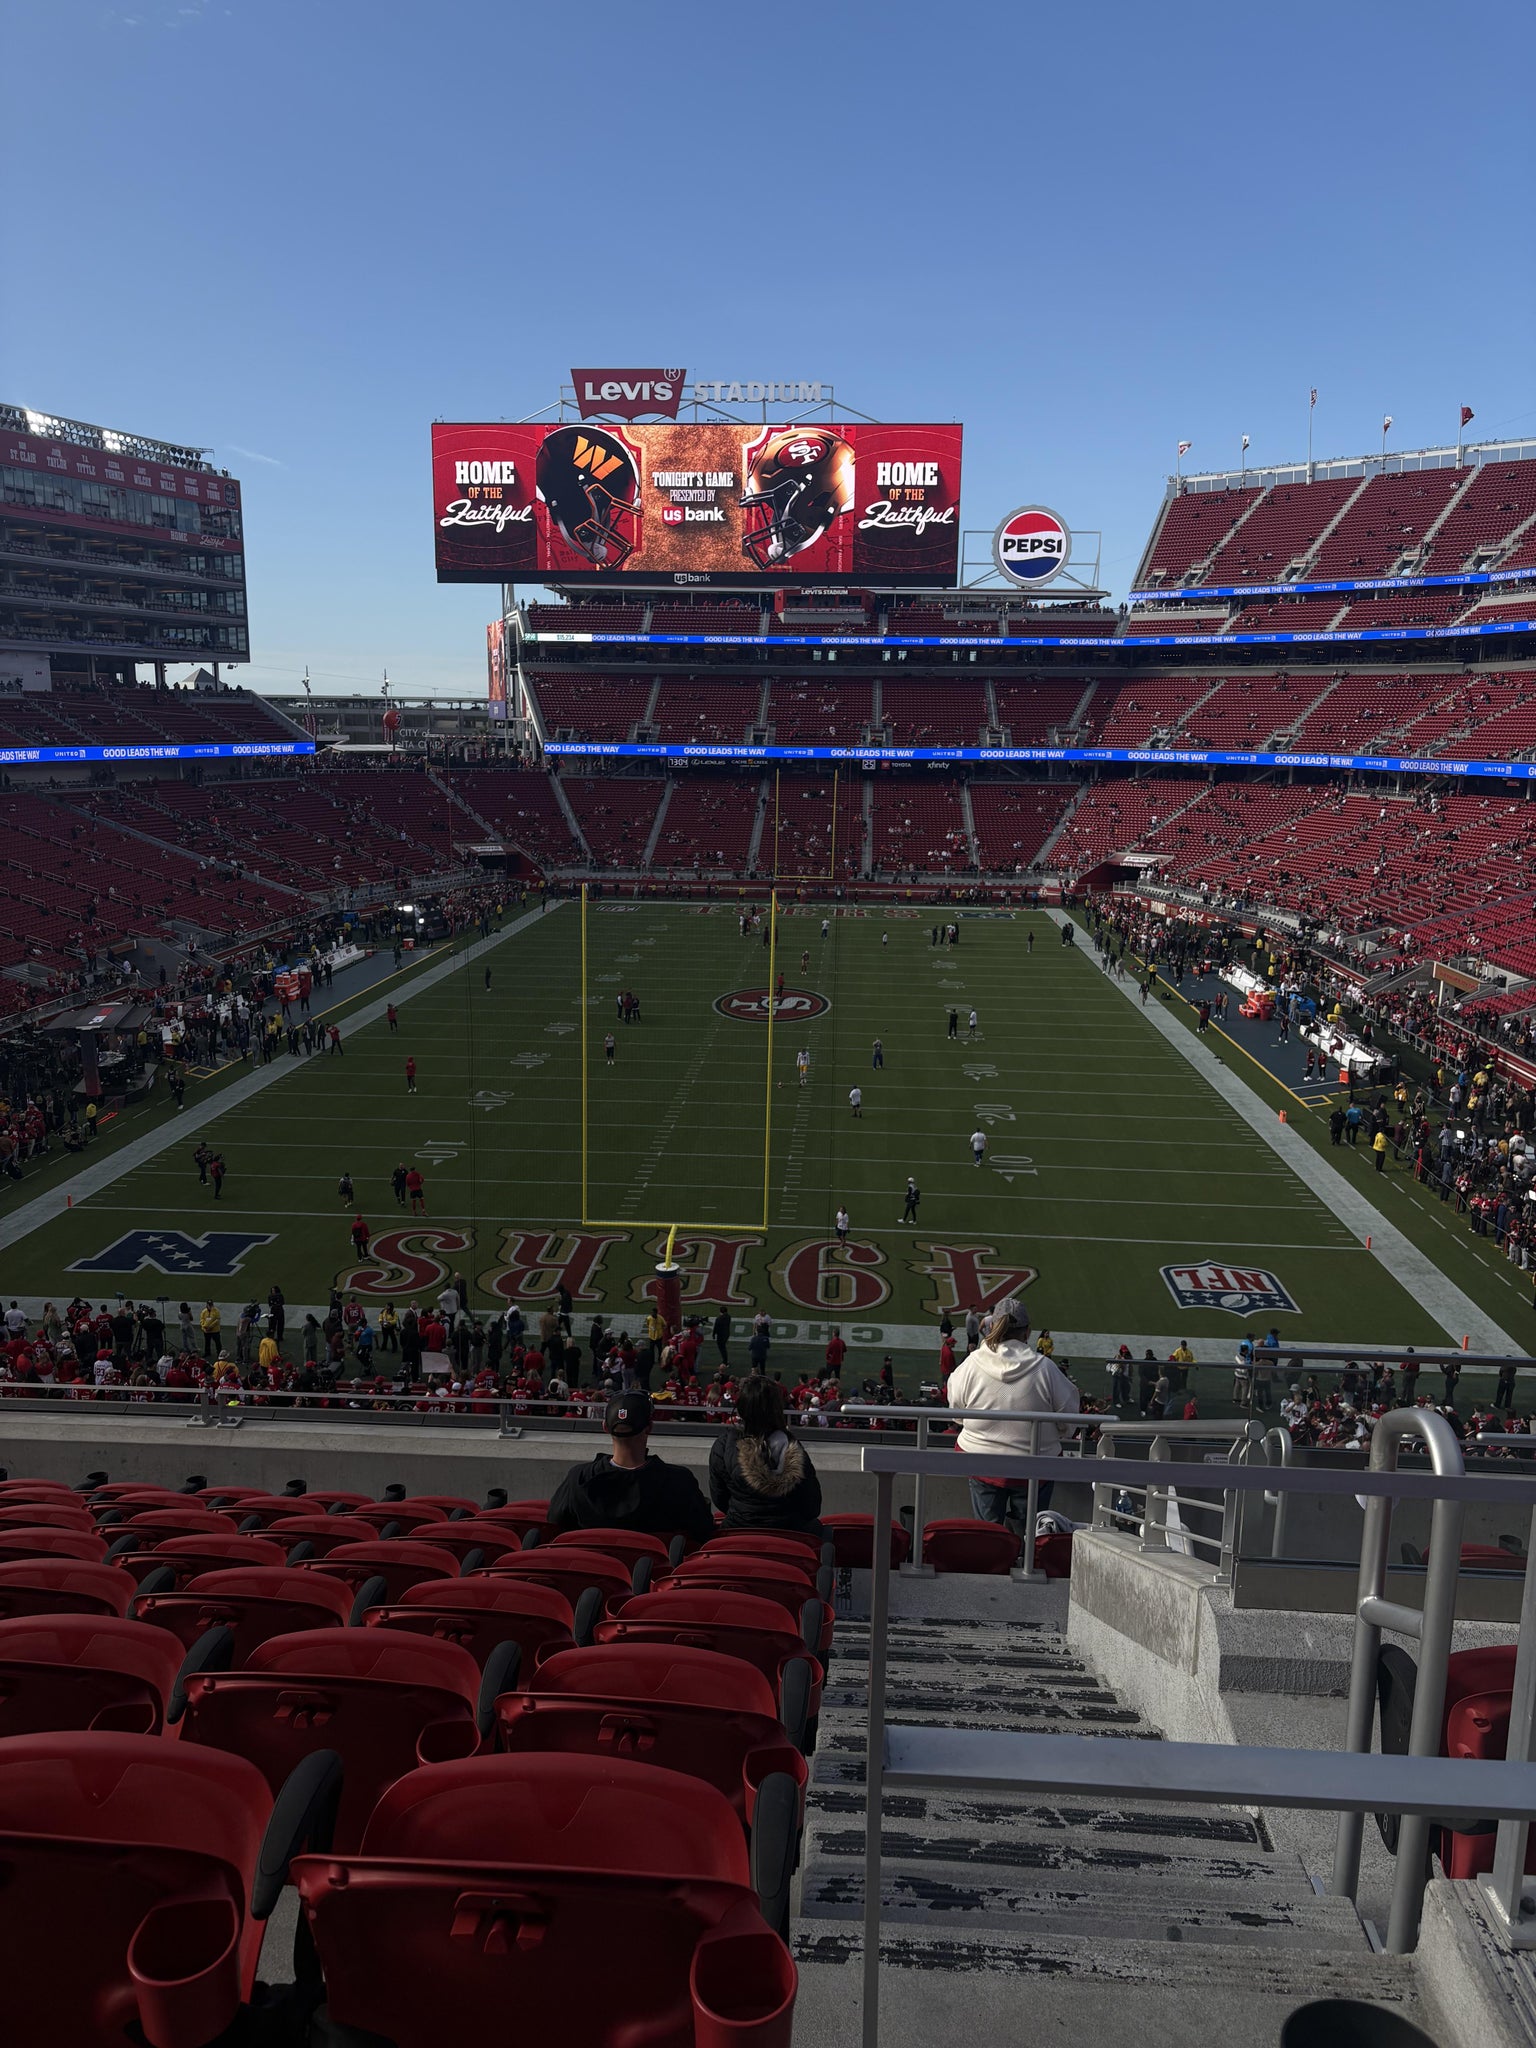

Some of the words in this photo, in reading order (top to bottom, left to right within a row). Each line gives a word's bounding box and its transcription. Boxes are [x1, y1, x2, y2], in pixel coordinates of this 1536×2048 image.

[695, 381, 821, 403] STADIUM
[455, 461, 514, 484] HOME
[877, 462, 938, 486] HOME
[652, 472, 703, 487] TONIGHT'S
[705, 472, 733, 487] GAME
[468, 487, 480, 499] OF
[483, 487, 502, 499] THE
[670, 490, 706, 501] PRESENTED
[707, 490, 715, 501] BY
[889, 489, 901, 500] OF
[905, 489, 924, 500] THE
[440, 499, 532, 533] Faithful
[663, 510, 682, 521] us
[685, 507, 725, 521] bank
[858, 501, 955, 535] Faithful
[1003, 538, 1062, 553] PEPSI
[688, 573, 710, 582] bank
[1127, 593, 1141, 601] OOD
[399, 729, 418, 738] CITY
[102, 748, 126, 758] GOOD
[127, 748, 149, 757] LEADS
[150, 747, 163, 757] THE
[163, 747, 179, 756] WAY
[232, 745, 250, 754] GOOD
[251, 745, 270, 754] LEADS
[270, 745, 281, 753] THE
[281, 744, 294, 753] WAY
[544, 744, 561, 752] OOD
[562, 744, 586, 753] LEADS
[587, 745, 601, 753] THE
[602, 745, 619, 753] WAY
[683, 747, 707, 755] GOOD
[708, 747, 732, 755] LEADS
[733, 747, 747, 755] THE
[830, 749, 854, 757] GOOD
[855, 749, 880, 757] LEADS
[881, 749, 895, 757] THE
[980, 750, 1004, 758] GOOD
[1005, 750, 1030, 758] LEADS
[1031, 750, 1046, 758] THE
[1046, 750, 1065, 758] WAY
[0, 750, 14, 761] EADS
[14, 750, 26, 761] THE
[26, 750, 39, 760] WAY
[1127, 751, 1150, 760] GOOD
[1151, 752, 1174, 761] LEADS
[1175, 752, 1189, 761] THE
[1190, 753, 1208, 761] WAY
[1274, 755, 1300, 764] GOOD
[1301, 756, 1328, 765] LEADS
[1330, 757, 1341, 766] THE
[1341, 757, 1353, 766] WAY
[928, 761, 950, 769] xfinity
[1399, 760, 1418, 770] GOOD
[1419, 761, 1439, 771] LEADS
[1440, 762, 1452, 772] THE
[1452, 763, 1468, 773] WAY
[331, 1226, 1039, 1316] 49ERS
[1173, 1267, 1273, 1292] NFL
